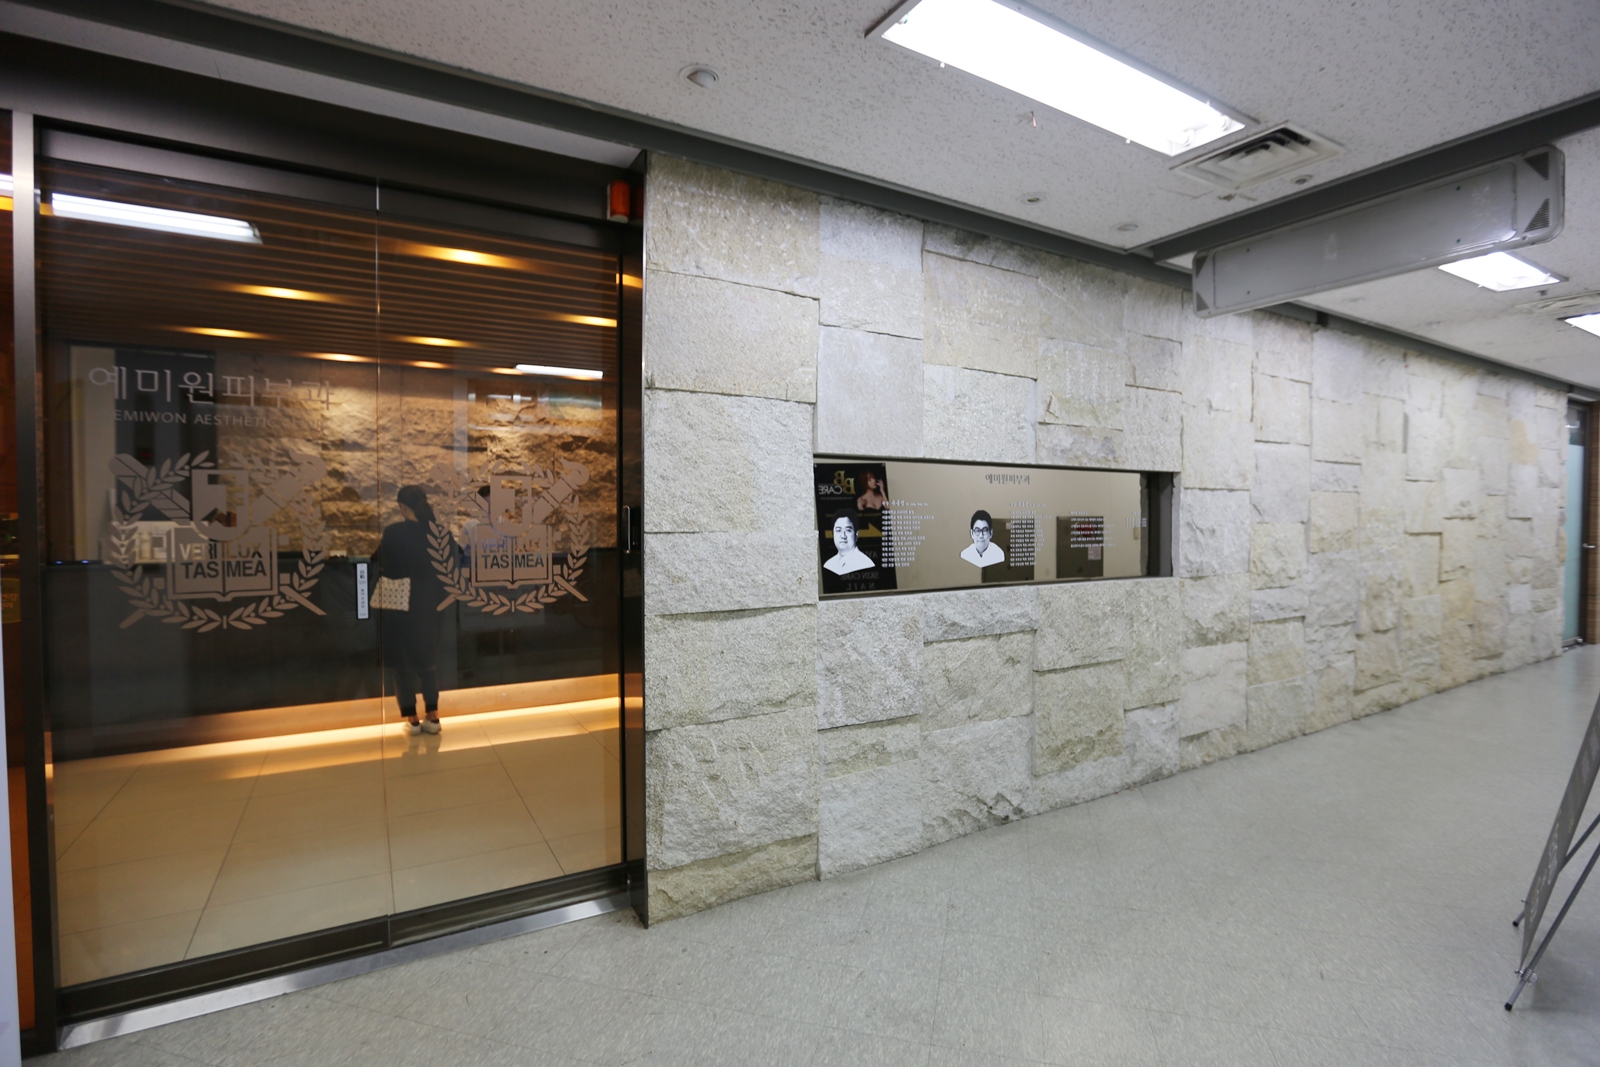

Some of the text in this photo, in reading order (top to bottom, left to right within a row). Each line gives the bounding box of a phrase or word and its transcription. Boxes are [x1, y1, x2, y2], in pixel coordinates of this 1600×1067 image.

[89, 366, 336, 411] 예미원피부과
[102, 409, 187, 424] EMIWON
[194, 413, 277, 428] AESTHETIC
[985, 473, 1031, 486] 예미원피부과
[180, 541, 262, 560] VERI LUX
[181, 560, 266, 579] TAS MEA
[481, 552, 544, 569] TAS MEA
